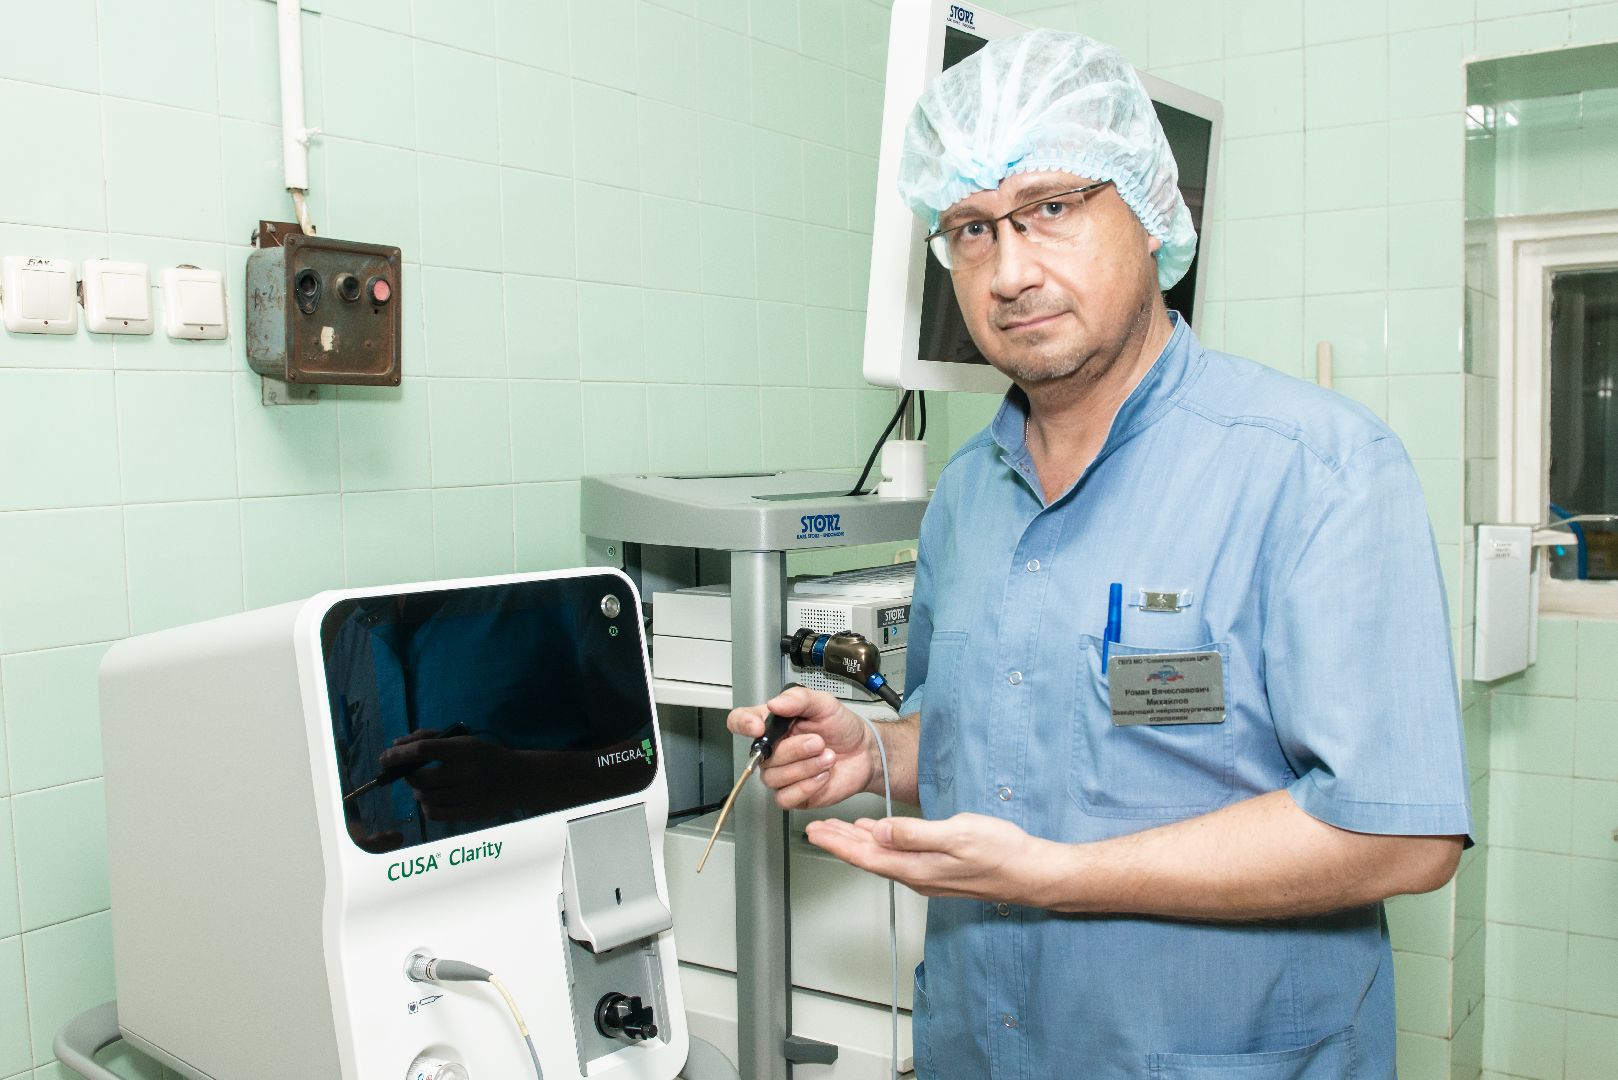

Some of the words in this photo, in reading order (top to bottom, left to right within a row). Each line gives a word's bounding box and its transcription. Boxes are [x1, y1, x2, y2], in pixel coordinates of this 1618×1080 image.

[950, 4, 974, 25] STORZ
[800, 513, 841, 533] STORZ
[885, 608, 905, 621] STORZ
[1151, 687, 1210, 695] Вячеславович
[1146, 697, 1189, 706] Михайлов
[597, 747, 643, 768] INTEGRA
[449, 841, 503, 866] Clarity
